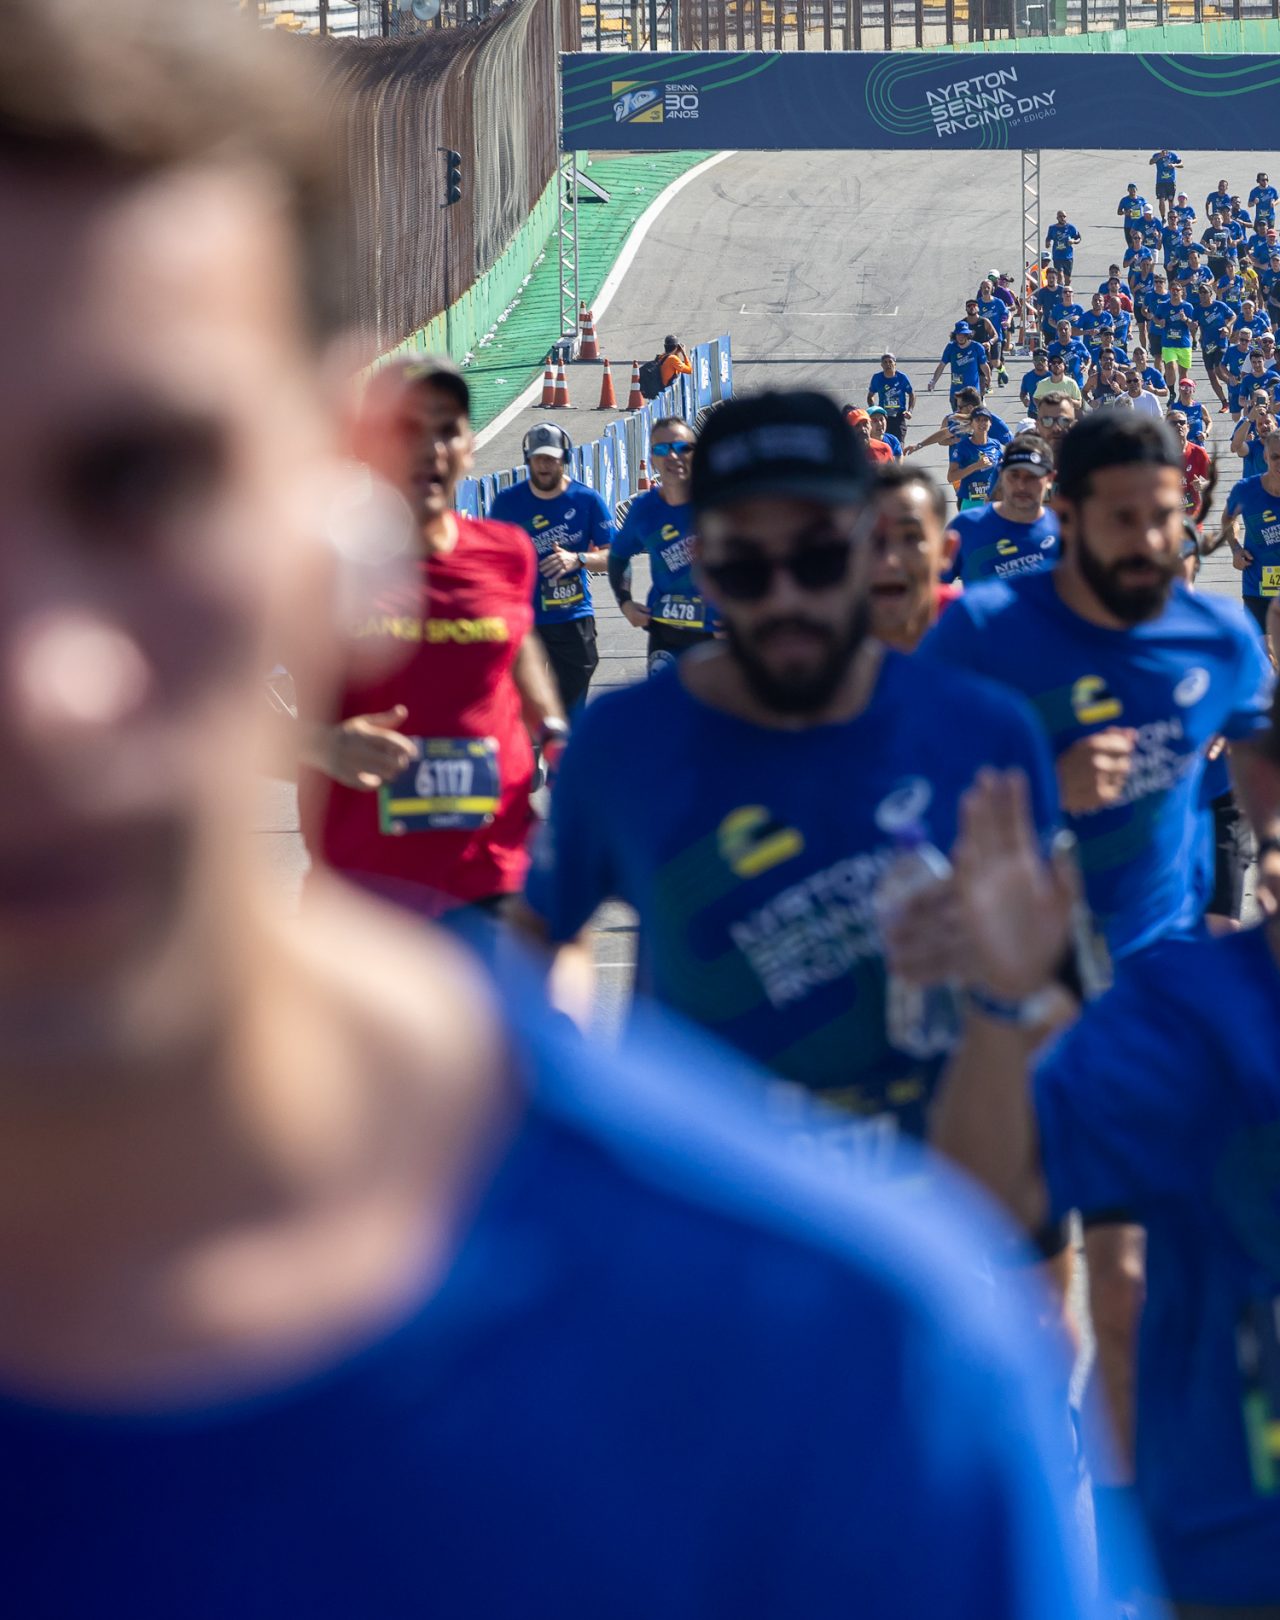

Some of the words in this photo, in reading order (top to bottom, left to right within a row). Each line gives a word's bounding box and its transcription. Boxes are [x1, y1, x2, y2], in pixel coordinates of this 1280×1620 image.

[665, 84, 698, 92] SENNA
[926, 66, 1018, 107] AYRTON
[665, 94, 699, 110] 30
[930, 88, 1017, 124] SENNA
[666, 110, 699, 119] ANOS
[935, 103, 1014, 138] RACING
[1017, 89, 1057, 115] DAY
[1023, 108, 1057, 124] EDIÇÃO
[994, 552, 1044, 574] AYRTON
[553, 583, 577, 599] 6869
[662, 603, 696, 620] 6478
[415, 758, 474, 797] 6117
